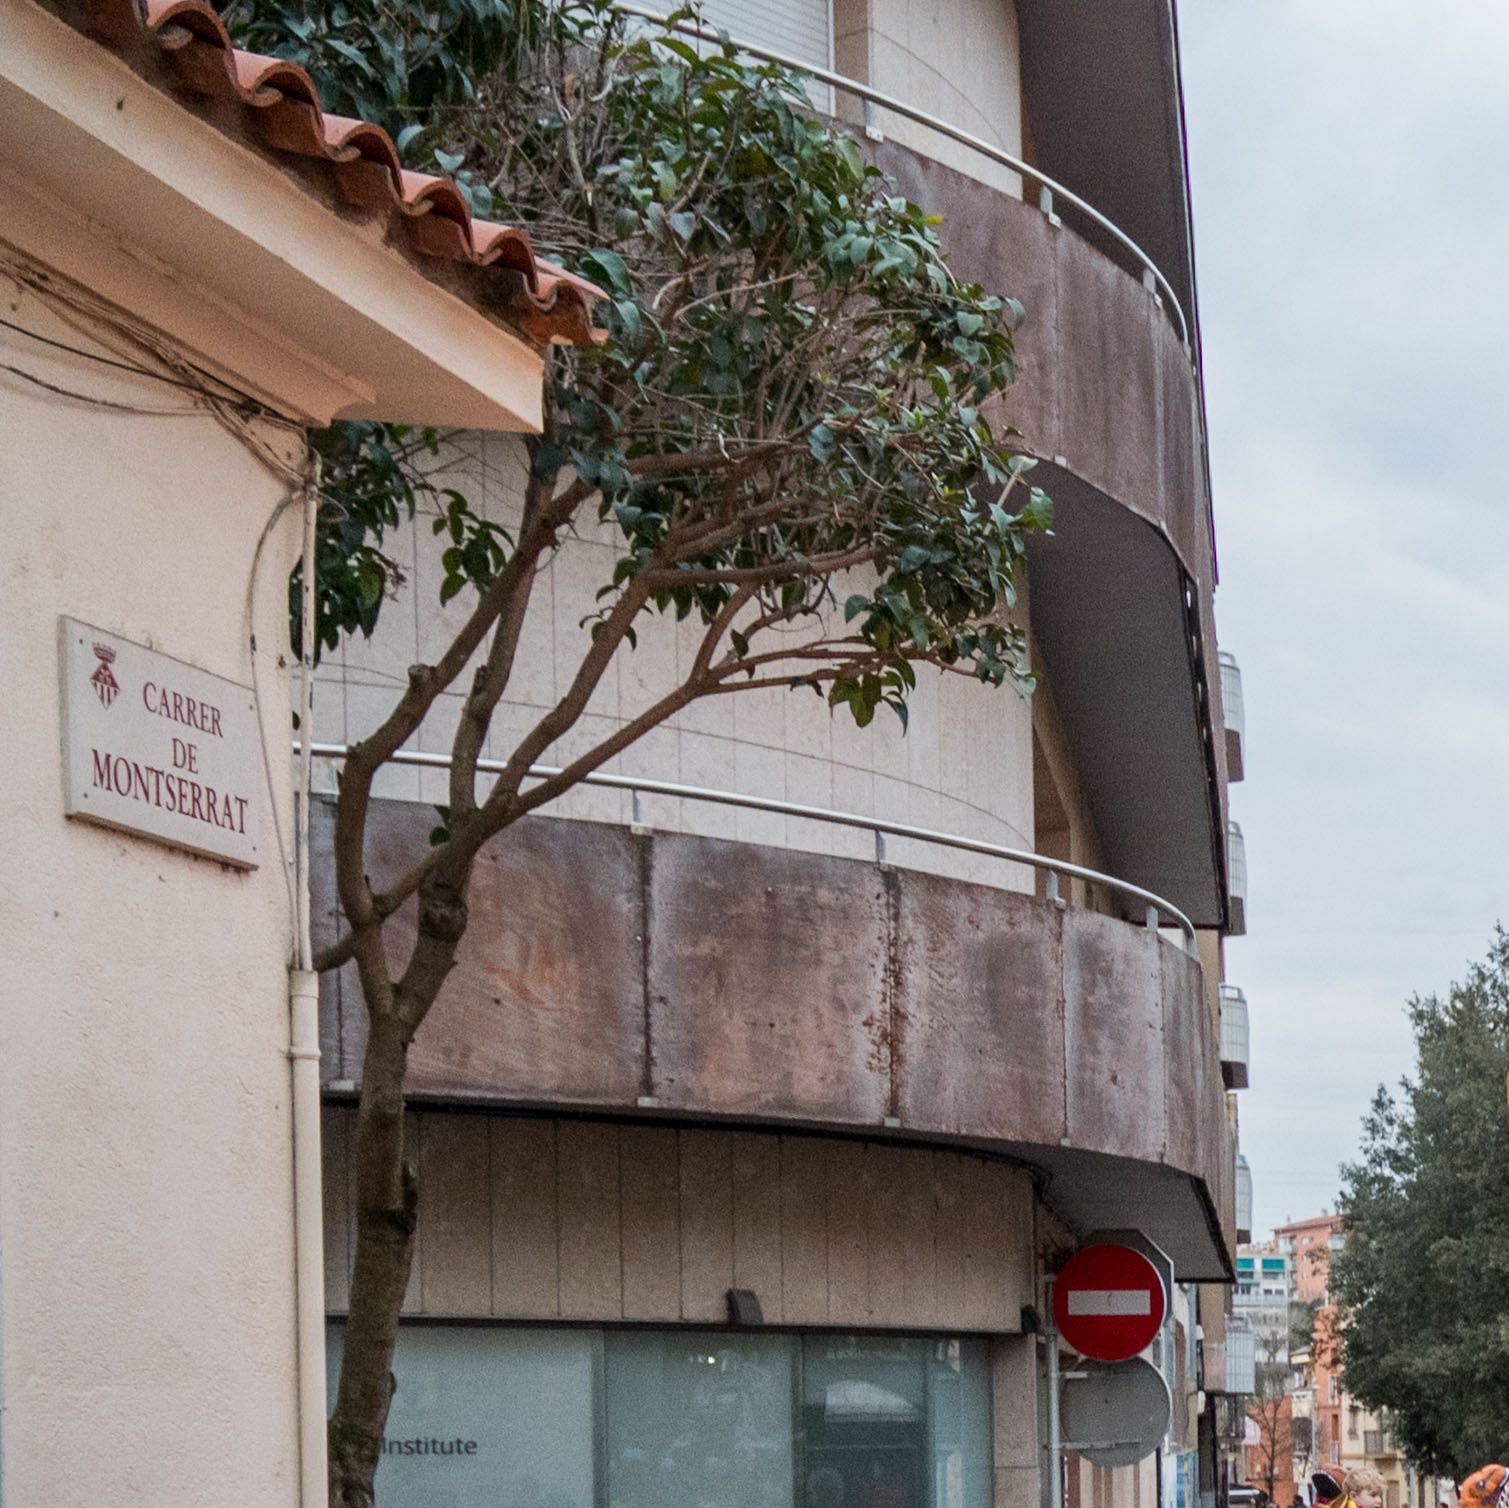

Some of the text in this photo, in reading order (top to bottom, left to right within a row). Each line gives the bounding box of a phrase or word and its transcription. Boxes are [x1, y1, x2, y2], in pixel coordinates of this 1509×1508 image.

[142, 681, 224, 738] CARRER
[171, 737, 200, 775] DE
[91, 748, 249, 835] MONTSERRAT
